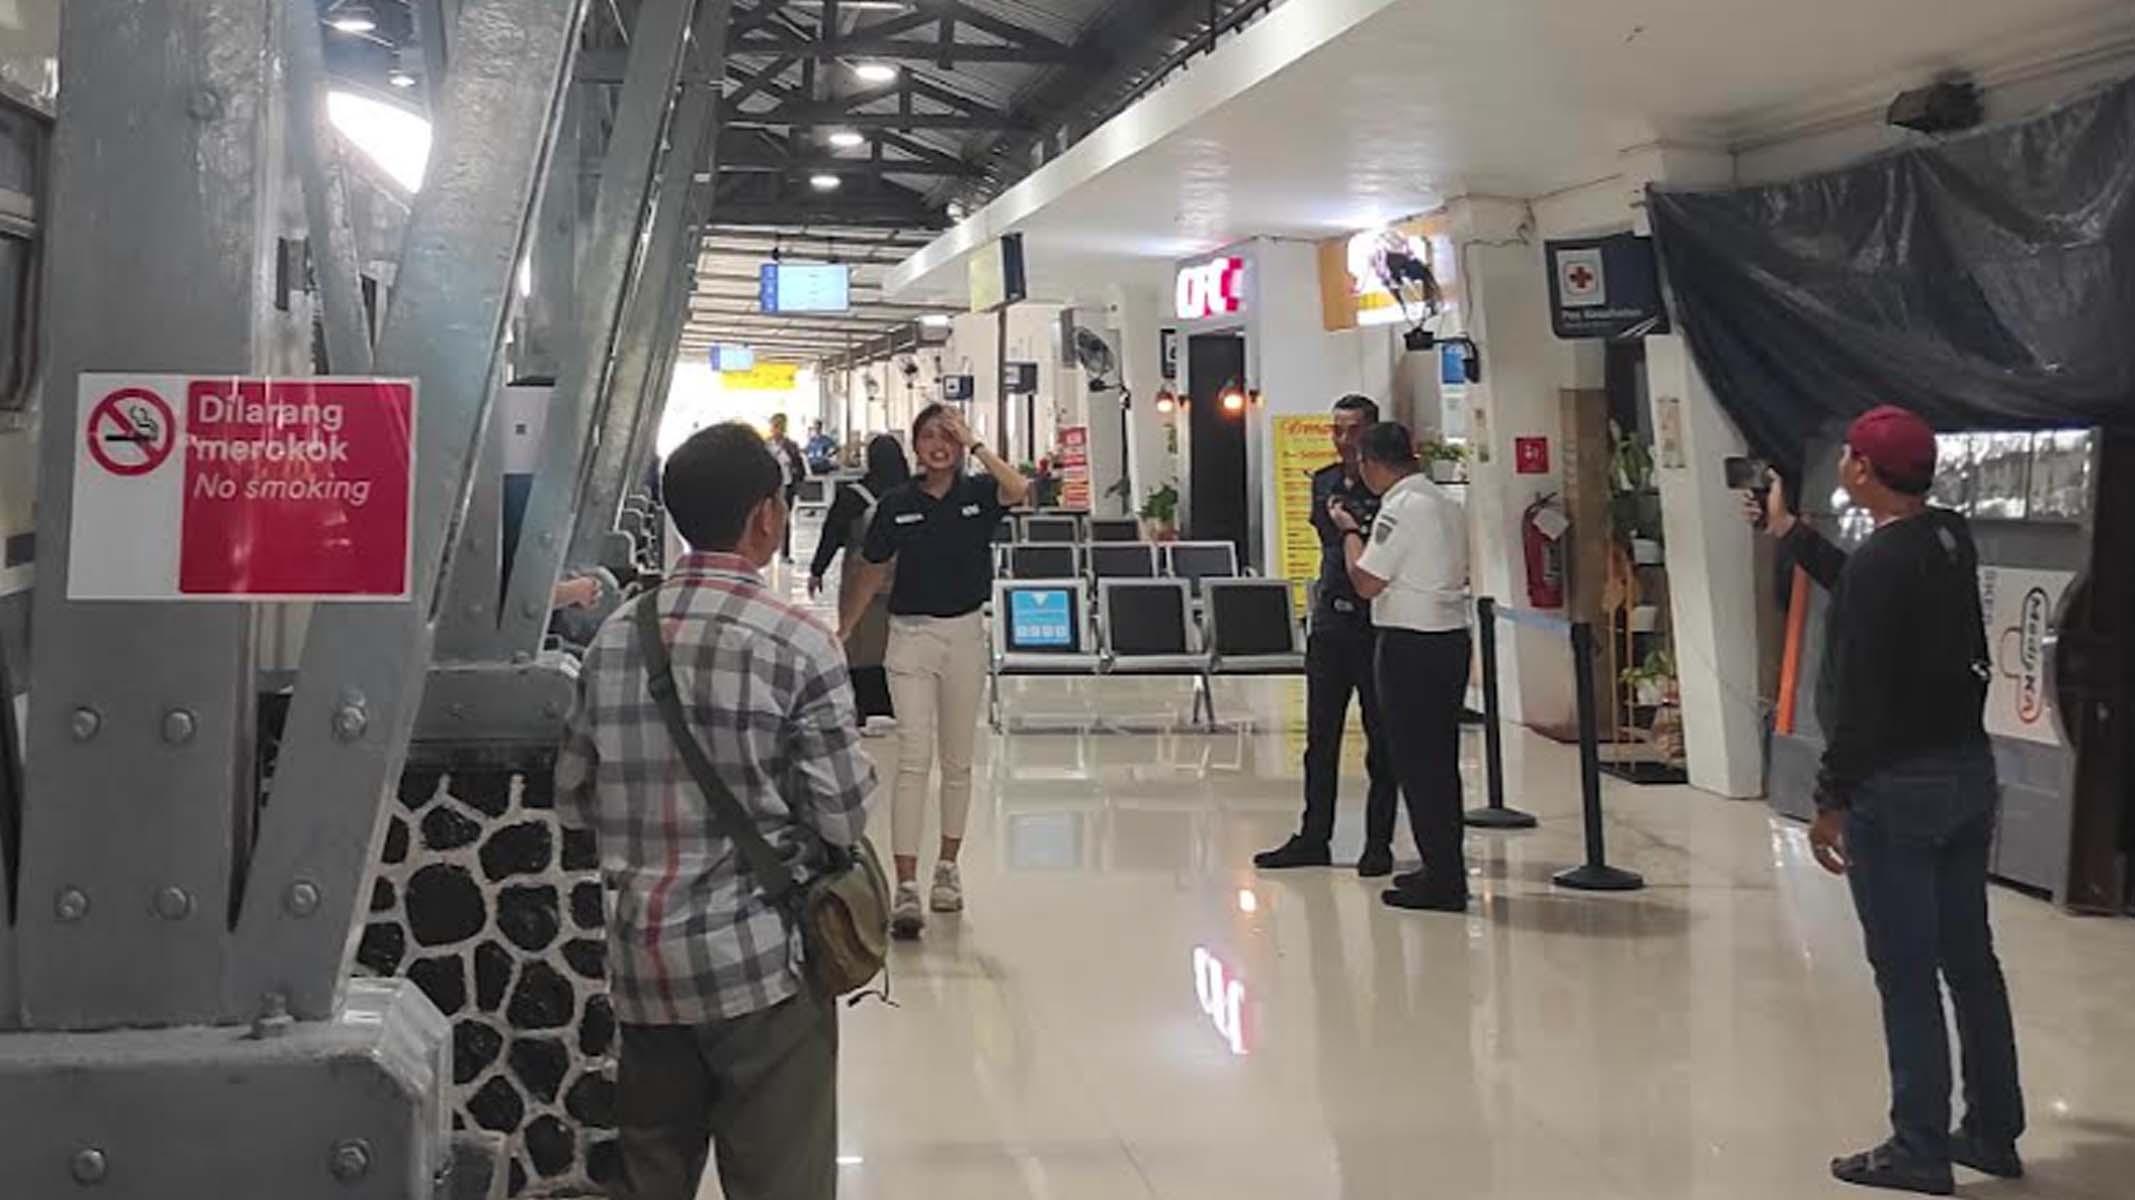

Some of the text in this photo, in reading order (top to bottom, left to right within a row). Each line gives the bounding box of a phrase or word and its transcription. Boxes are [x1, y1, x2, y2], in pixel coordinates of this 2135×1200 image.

[199, 395, 343, 431] Dilarang
[197, 433, 349, 461] merokok
[193, 473, 371, 506] No smoking
